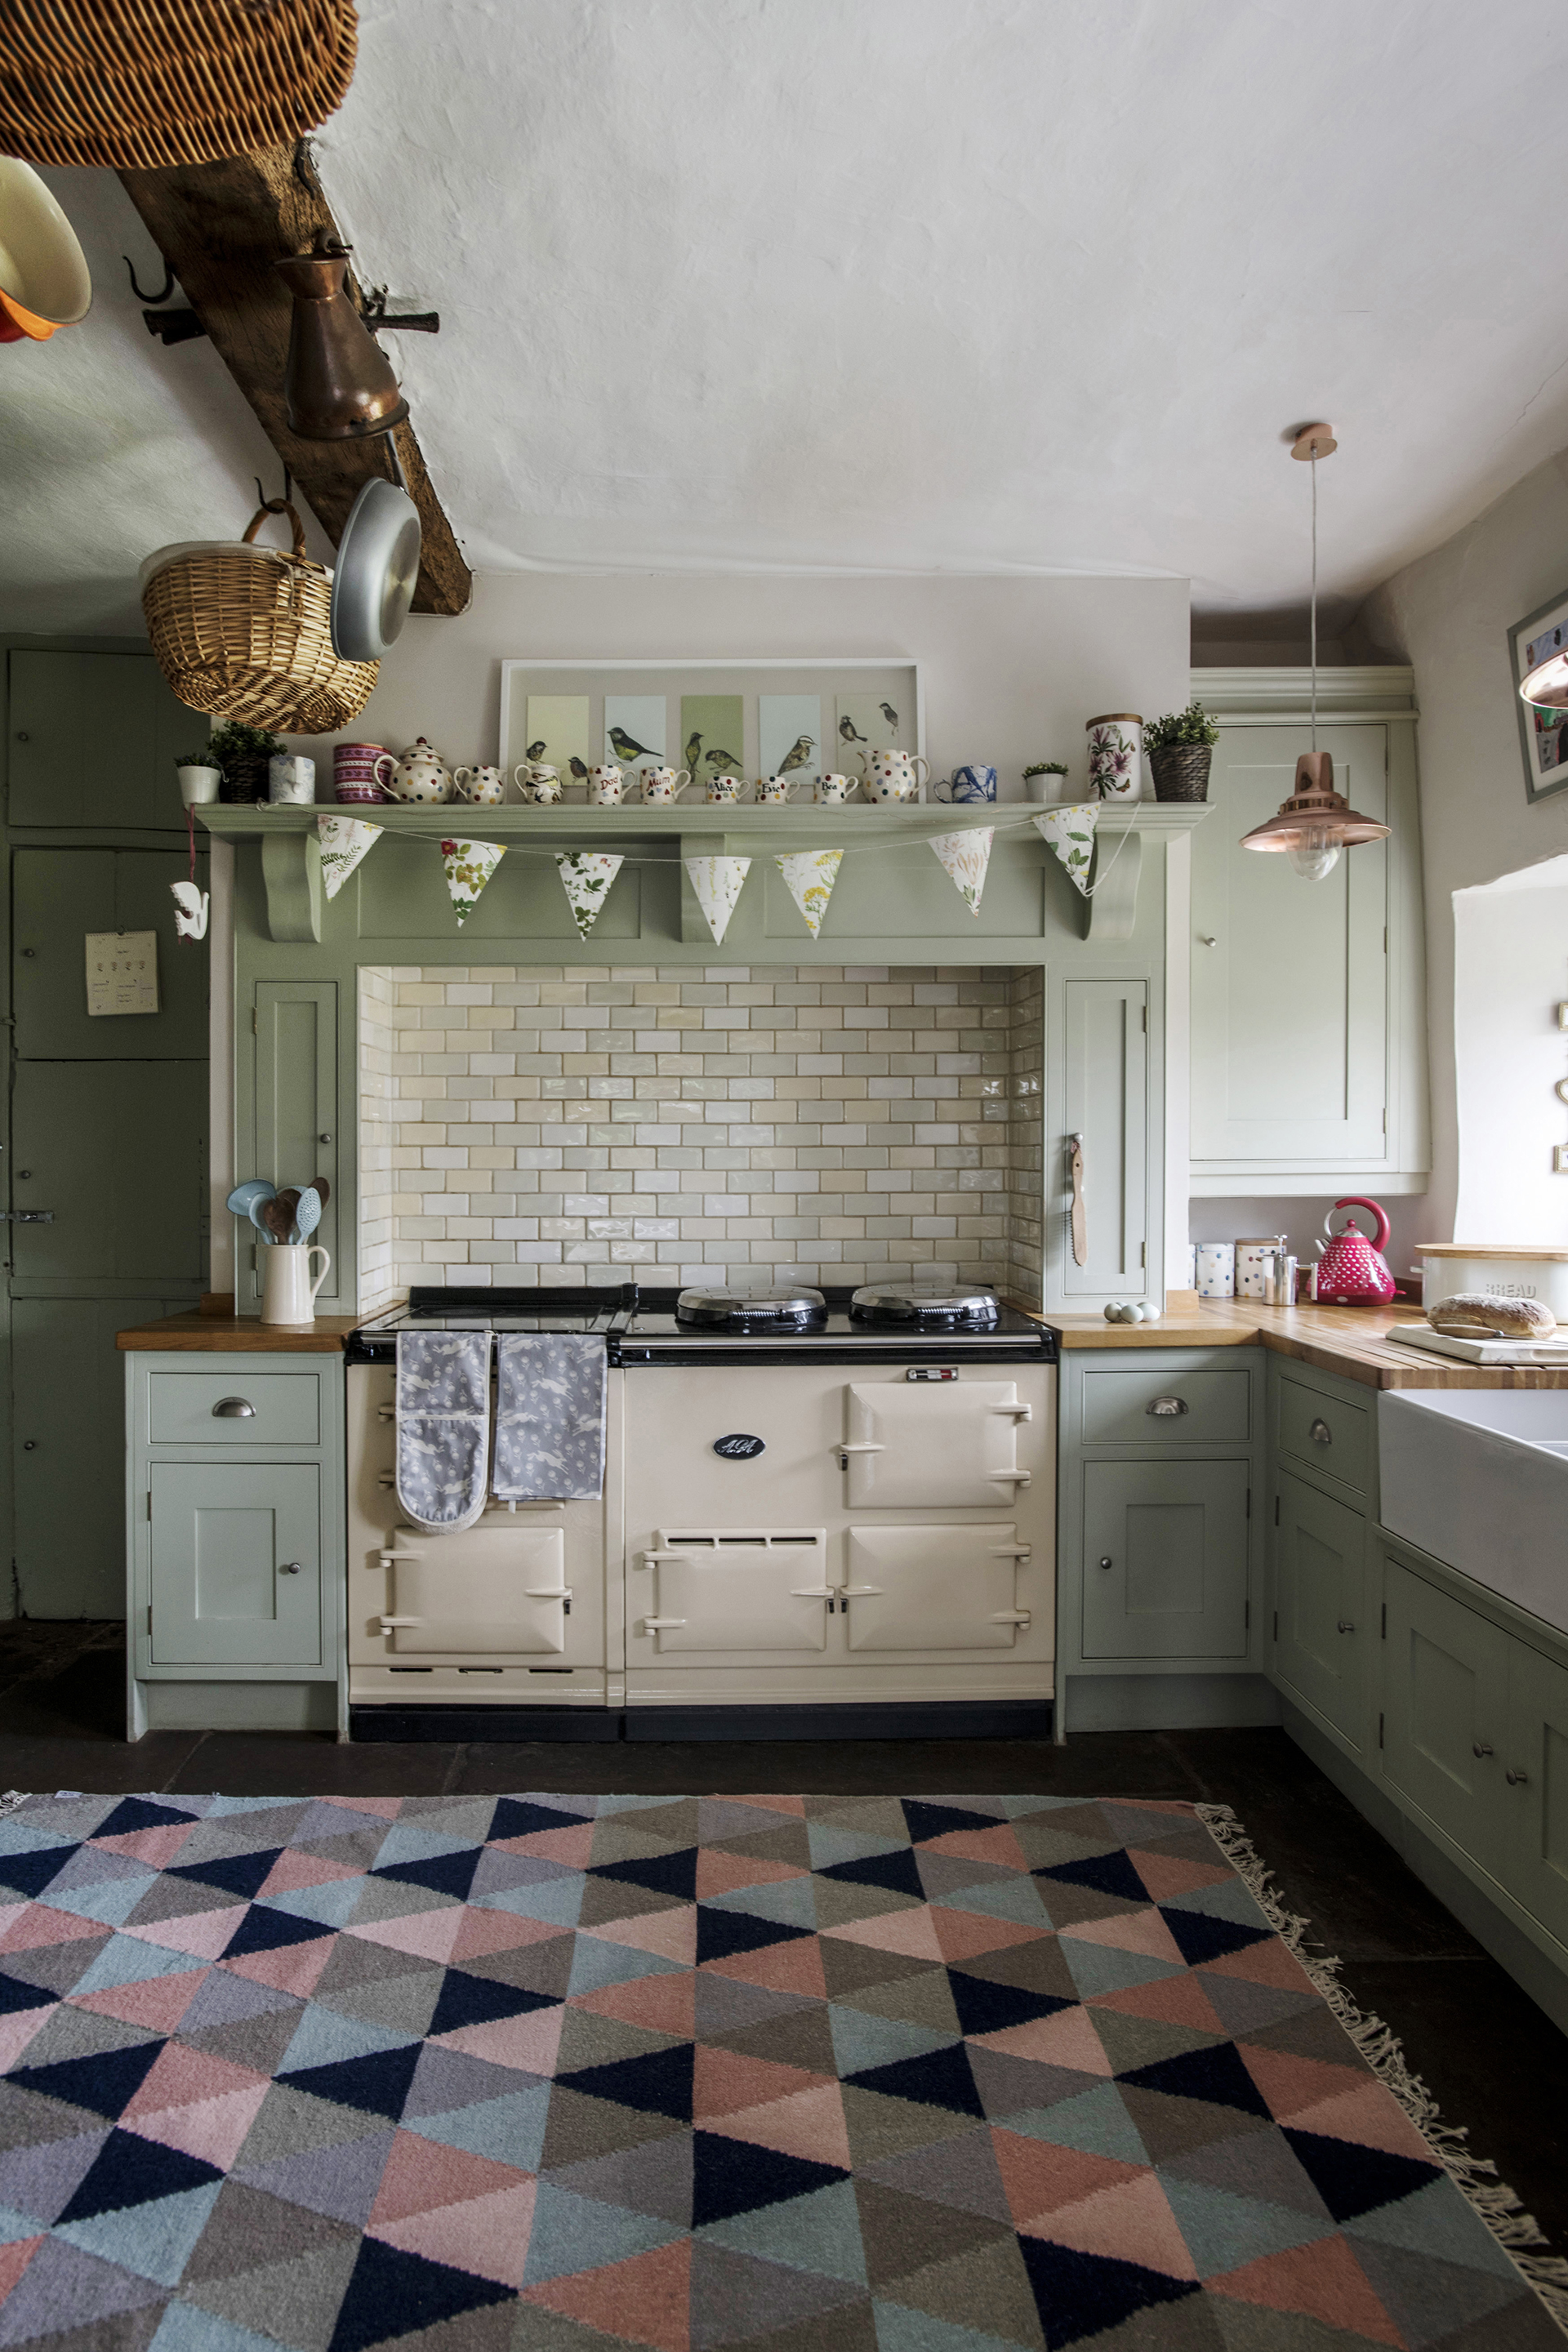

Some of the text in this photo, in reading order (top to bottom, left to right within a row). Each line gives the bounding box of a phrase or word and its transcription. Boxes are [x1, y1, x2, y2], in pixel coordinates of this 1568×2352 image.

[599, 774, 618, 791] Dad
[646, 777, 670, 791] Mum
[711, 782, 734, 791] Alice
[822, 782, 838, 791] Bea
[1486, 1284, 1537, 1298] BREAD
[717, 1439, 759, 1454] AGA
